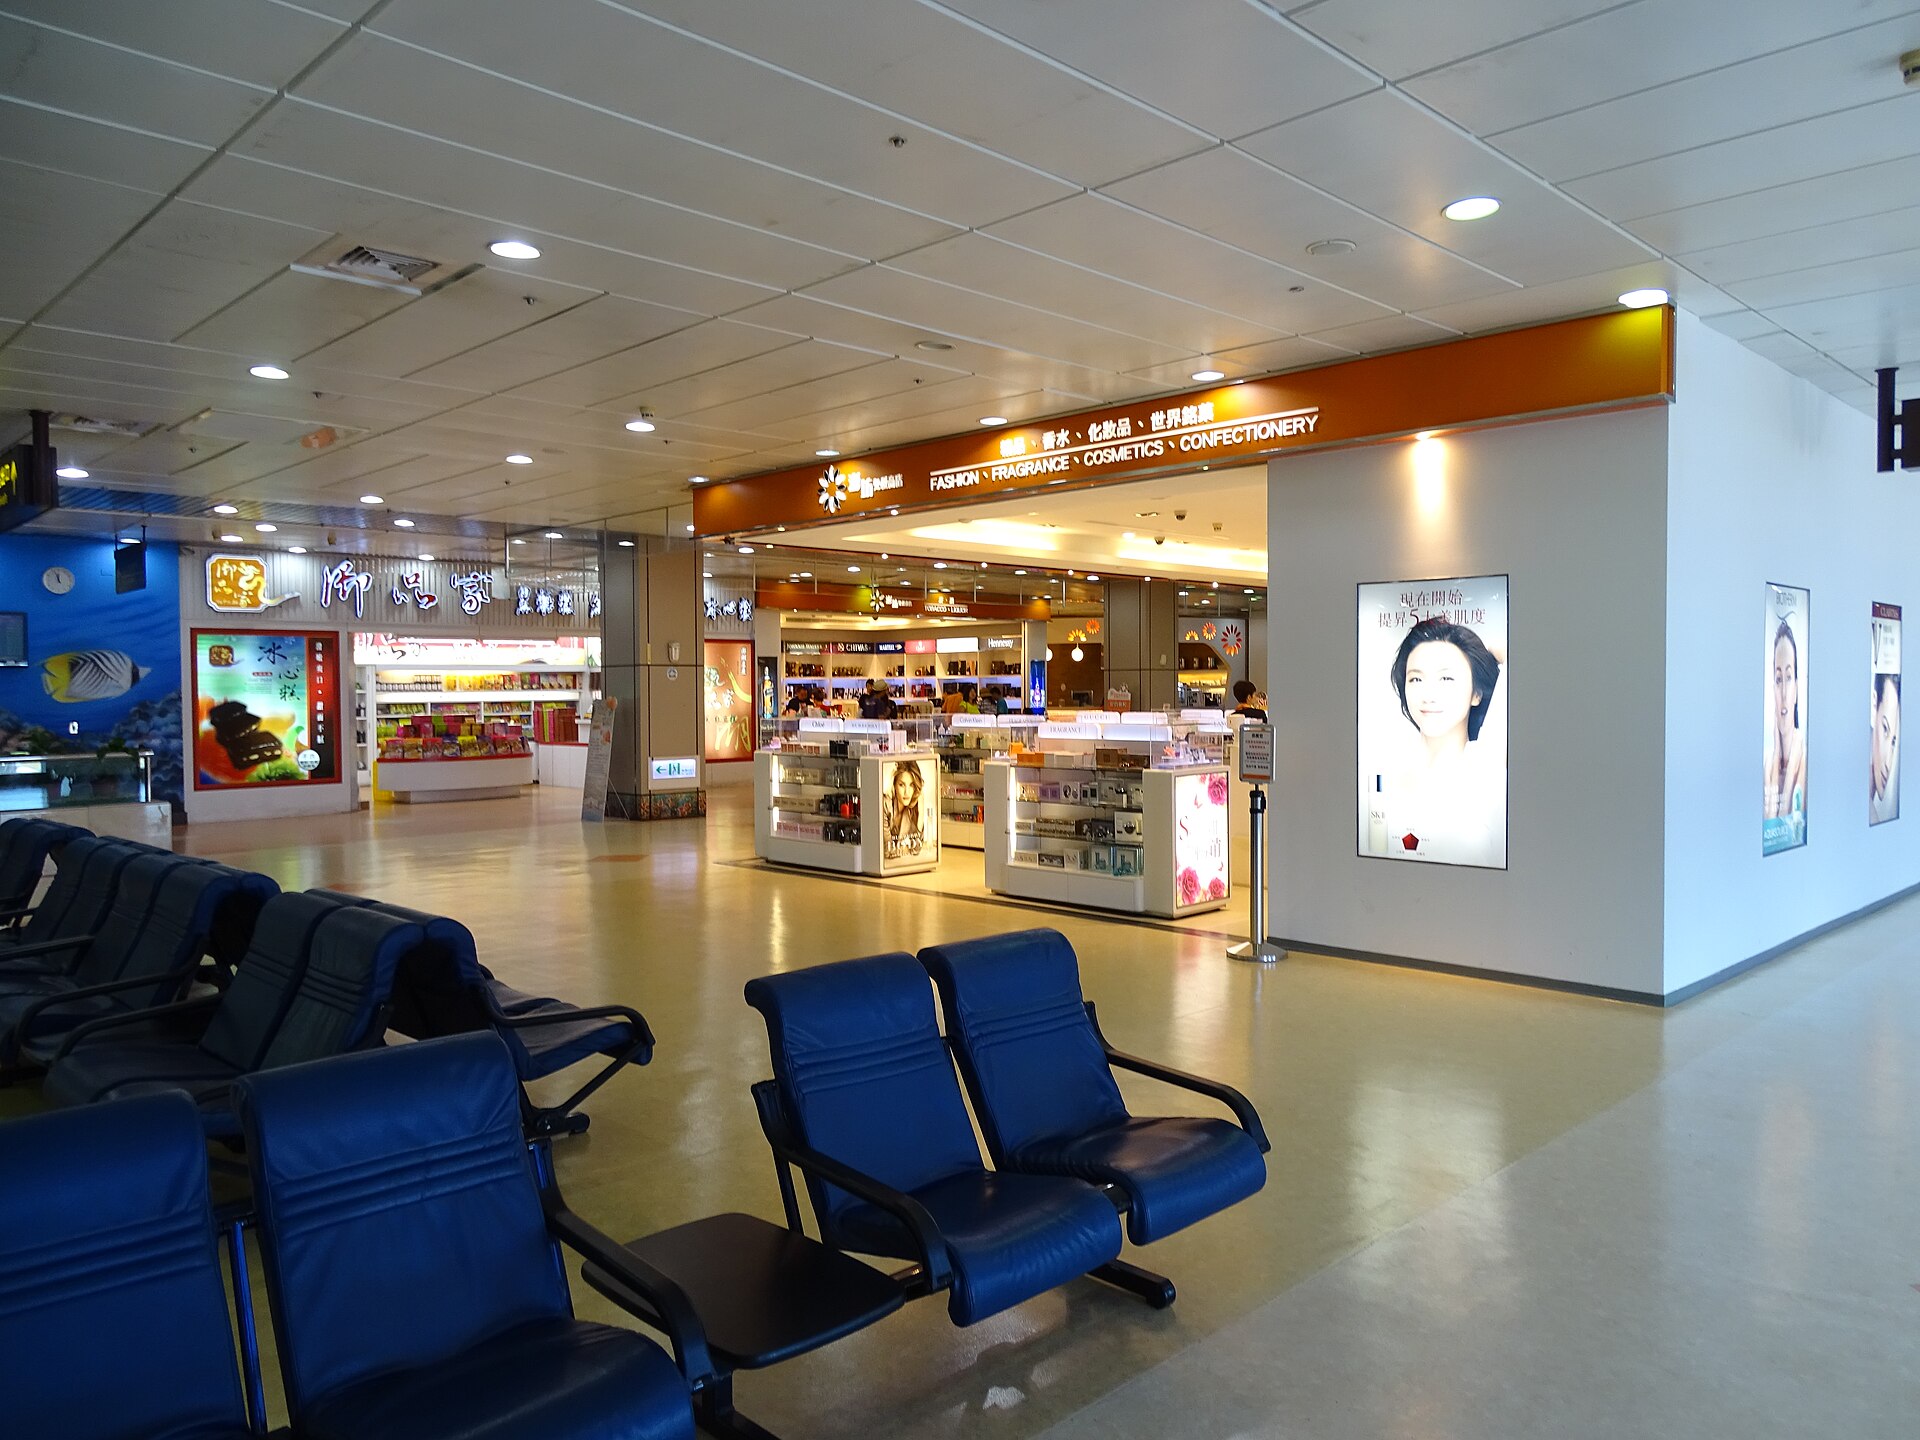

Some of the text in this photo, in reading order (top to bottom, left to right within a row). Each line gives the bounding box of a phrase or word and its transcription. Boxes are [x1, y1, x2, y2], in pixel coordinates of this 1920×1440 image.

[930, 415, 1319, 491] FASHION FRAGRANCE COSMETICS CONFECTIONERY
[1400, 589, 1463, 608] 現在開始
[845, 643, 869, 652] CHIVAS
[987, 638, 1014, 649] Hennessy
